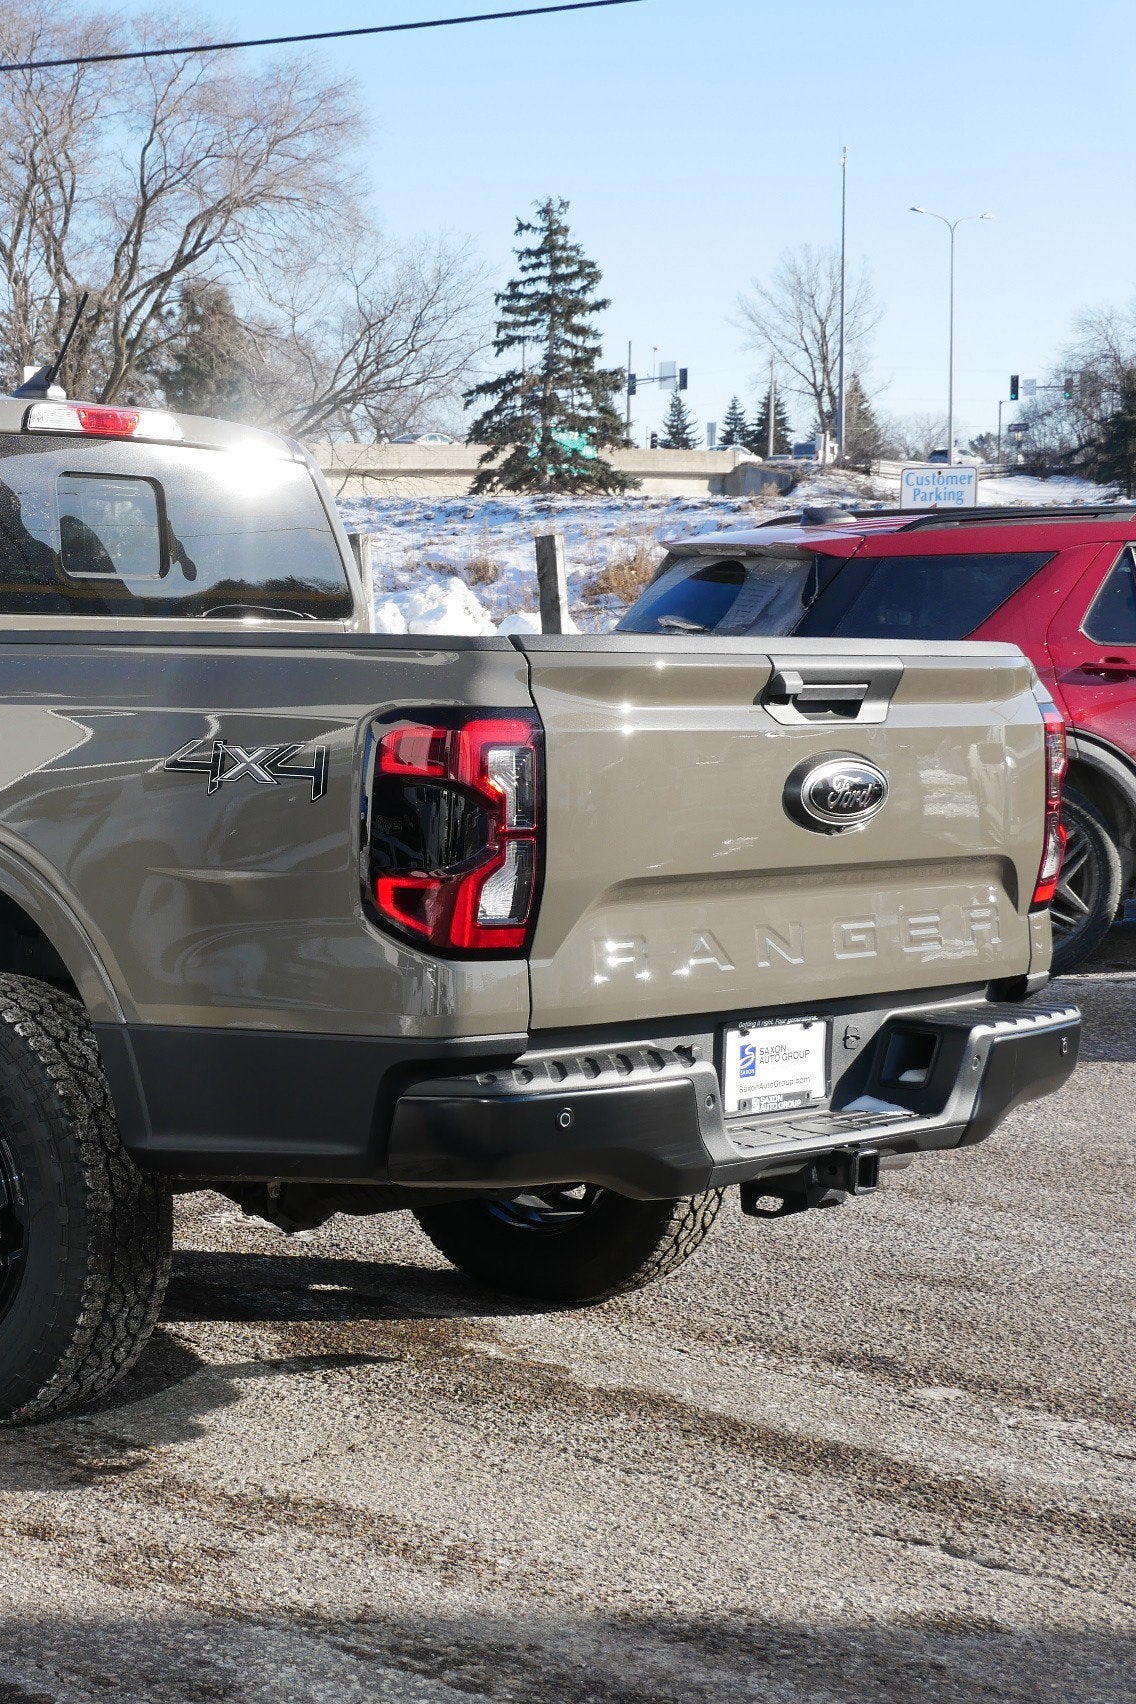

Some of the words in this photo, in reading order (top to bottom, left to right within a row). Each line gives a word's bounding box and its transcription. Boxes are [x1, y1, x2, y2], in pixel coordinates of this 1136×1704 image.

[905, 472, 973, 487] Customer
[912, 487, 965, 505] Parking
[827, 774, 873, 809] Ford
[593, 903, 1001, 983] RANGER
[759, 1044, 787, 1056] SAXON
[759, 1053, 781, 1064] AUTO
[782, 1050, 810, 1061] GROUP
[739, 1076, 811, 1093] SaxonAutoGroup.com
[760, 1094, 783, 1103] SAXON
[760, 1101, 778, 1111] AUTO
[778, 1099, 802, 1110] GROUP
